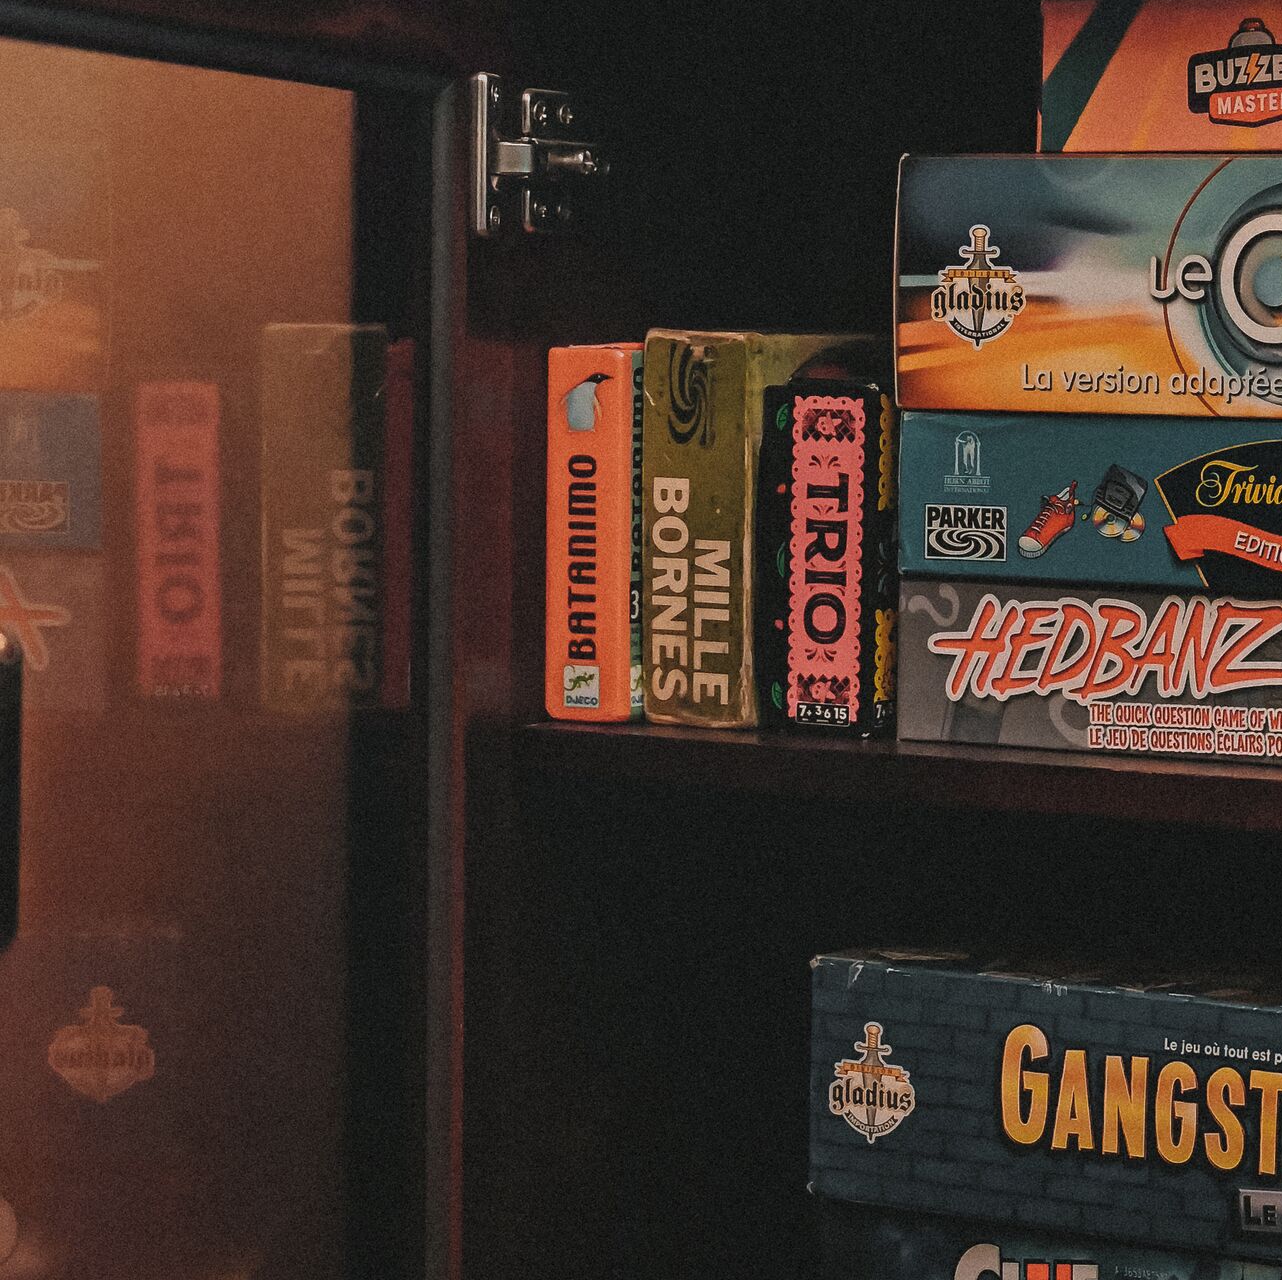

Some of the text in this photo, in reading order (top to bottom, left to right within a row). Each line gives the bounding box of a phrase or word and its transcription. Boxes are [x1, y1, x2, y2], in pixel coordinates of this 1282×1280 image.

[933, 283, 1024, 319] gladius
[1021, 364, 1052, 391] La
[1062, 365, 1159, 394] version
[926, 506, 1006, 529] PARKER
[567, 453, 598, 660] BATANIMO
[803, 472, 850, 645] TRIO
[651, 476, 690, 701] BORNES
[692, 538, 731, 705] MILLE
[833, 707, 847, 720] 15
[1089, 703, 1112, 722] THE
[1115, 705, 1150, 724] QUICK
[1154, 705, 1210, 726] QUESTION
[1213, 708, 1246, 728] GAME
[1249, 709, 1265, 730] OF
[1089, 728, 1101, 746] LE
[1106, 729, 1128, 747] JEU
[1130, 730, 1146, 748] DE
[1150, 730, 1212, 750] QUESTIONS
[1215, 730, 1264, 753] ÉCLAIRS
[1163, 1037, 1178, 1051] Le
[1180, 1039, 1200, 1055] jeu
[1204, 1042, 1220, 1057] où
[1223, 1044, 1249, 1060] tout
[1252, 1049, 1271, 1062] est
[832, 1079, 913, 1112] gladius
[847, 1114, 897, 1134] IMPORTATION
